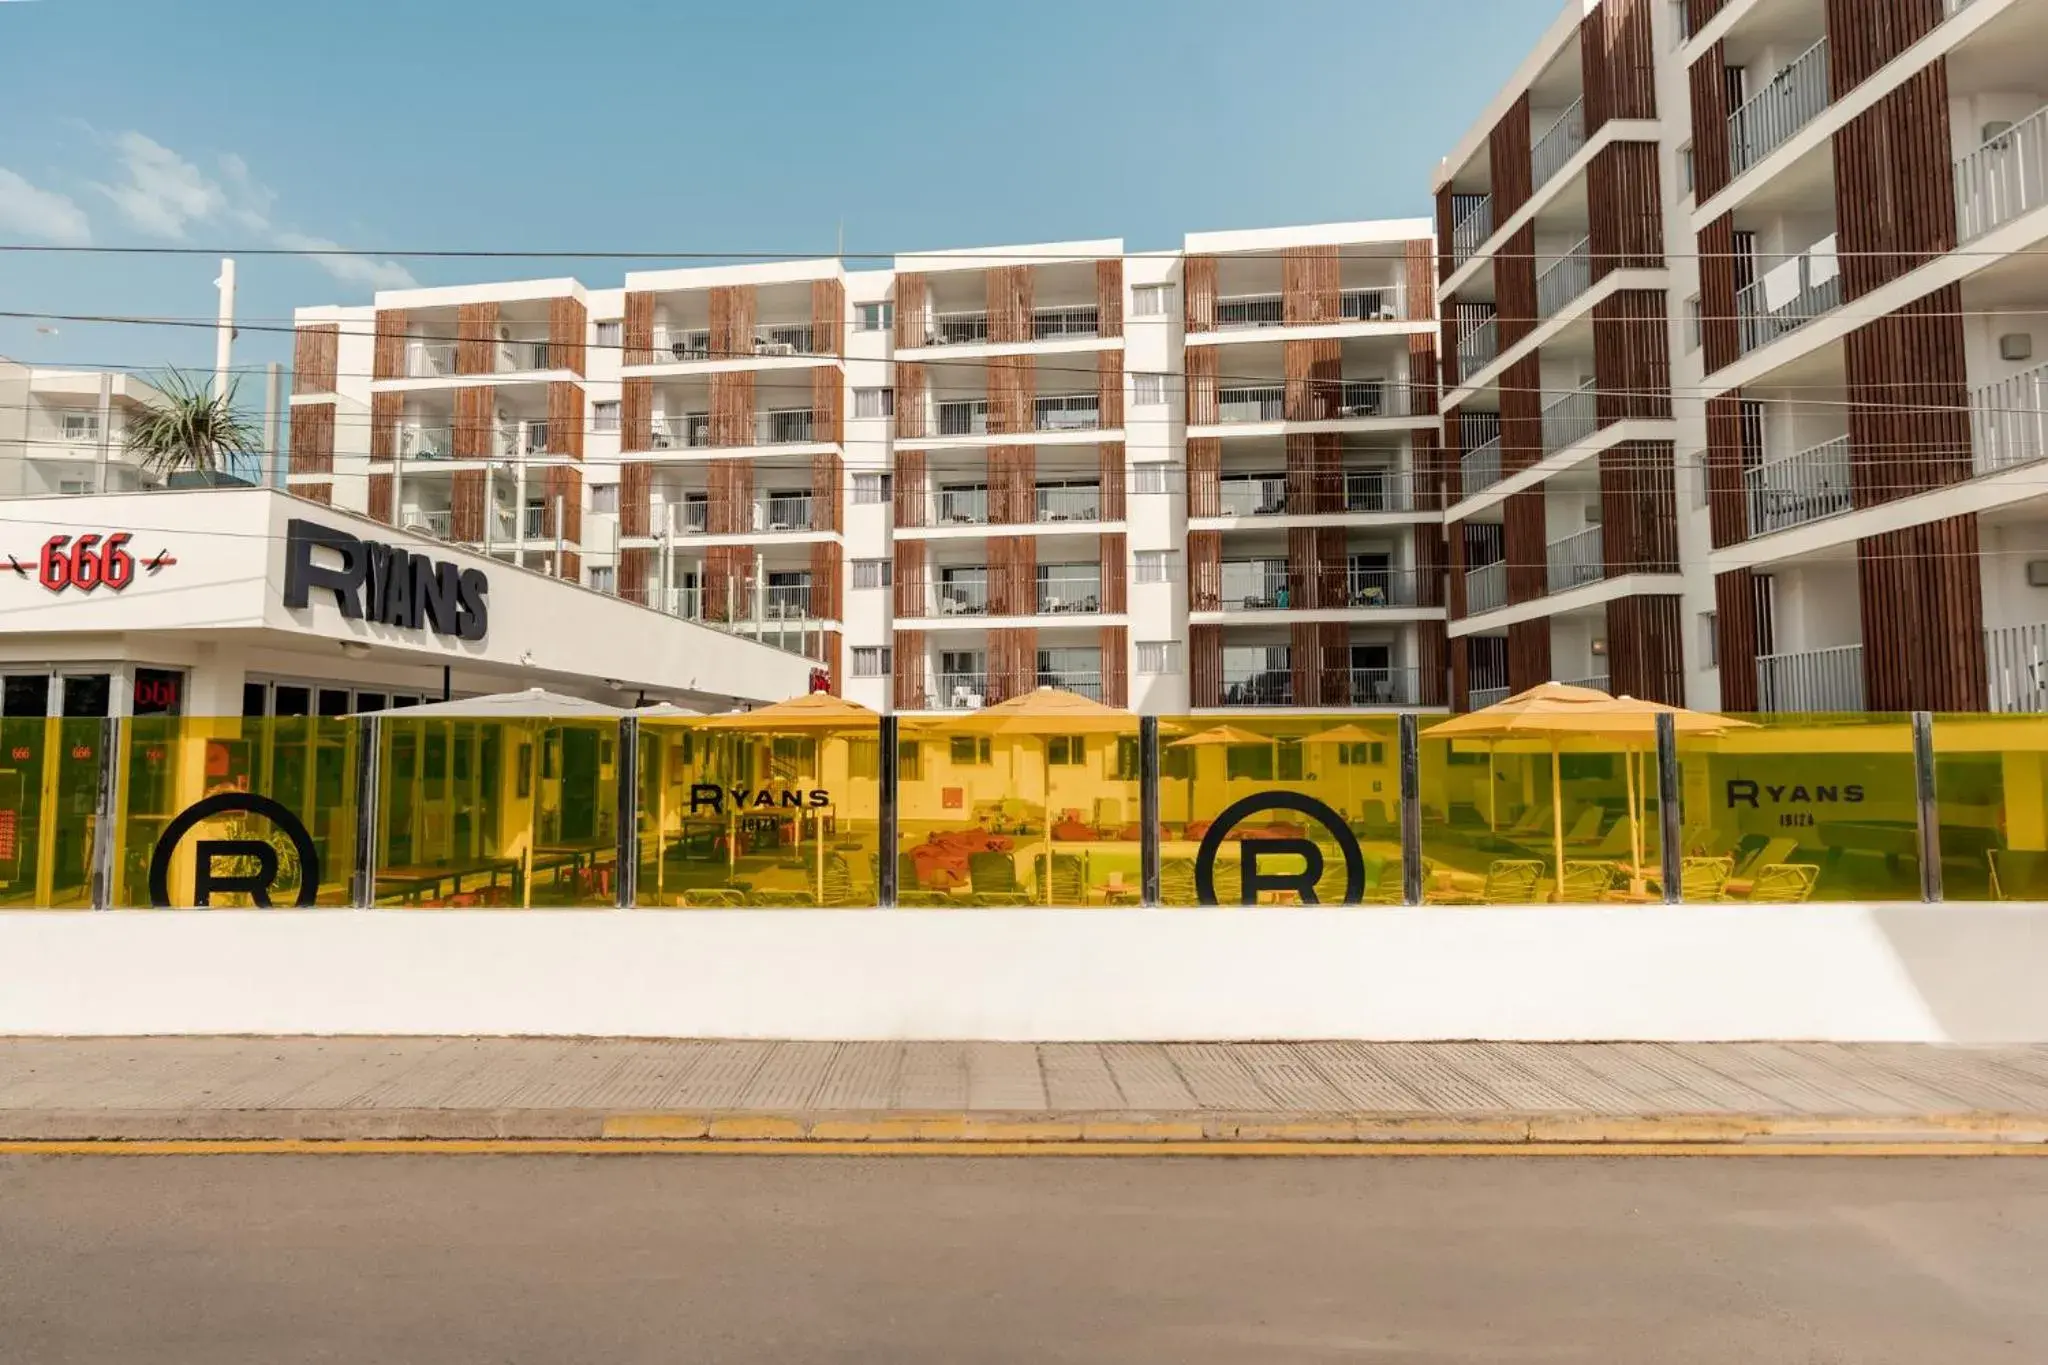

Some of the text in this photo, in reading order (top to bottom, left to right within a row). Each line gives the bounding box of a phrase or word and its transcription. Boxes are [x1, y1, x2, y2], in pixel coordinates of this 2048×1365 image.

[39, 533, 133, 591] 666
[284, 519, 488, 640] RYANS
[691, 784, 829, 813] RYANS
[1727, 780, 1865, 809] RYANS
